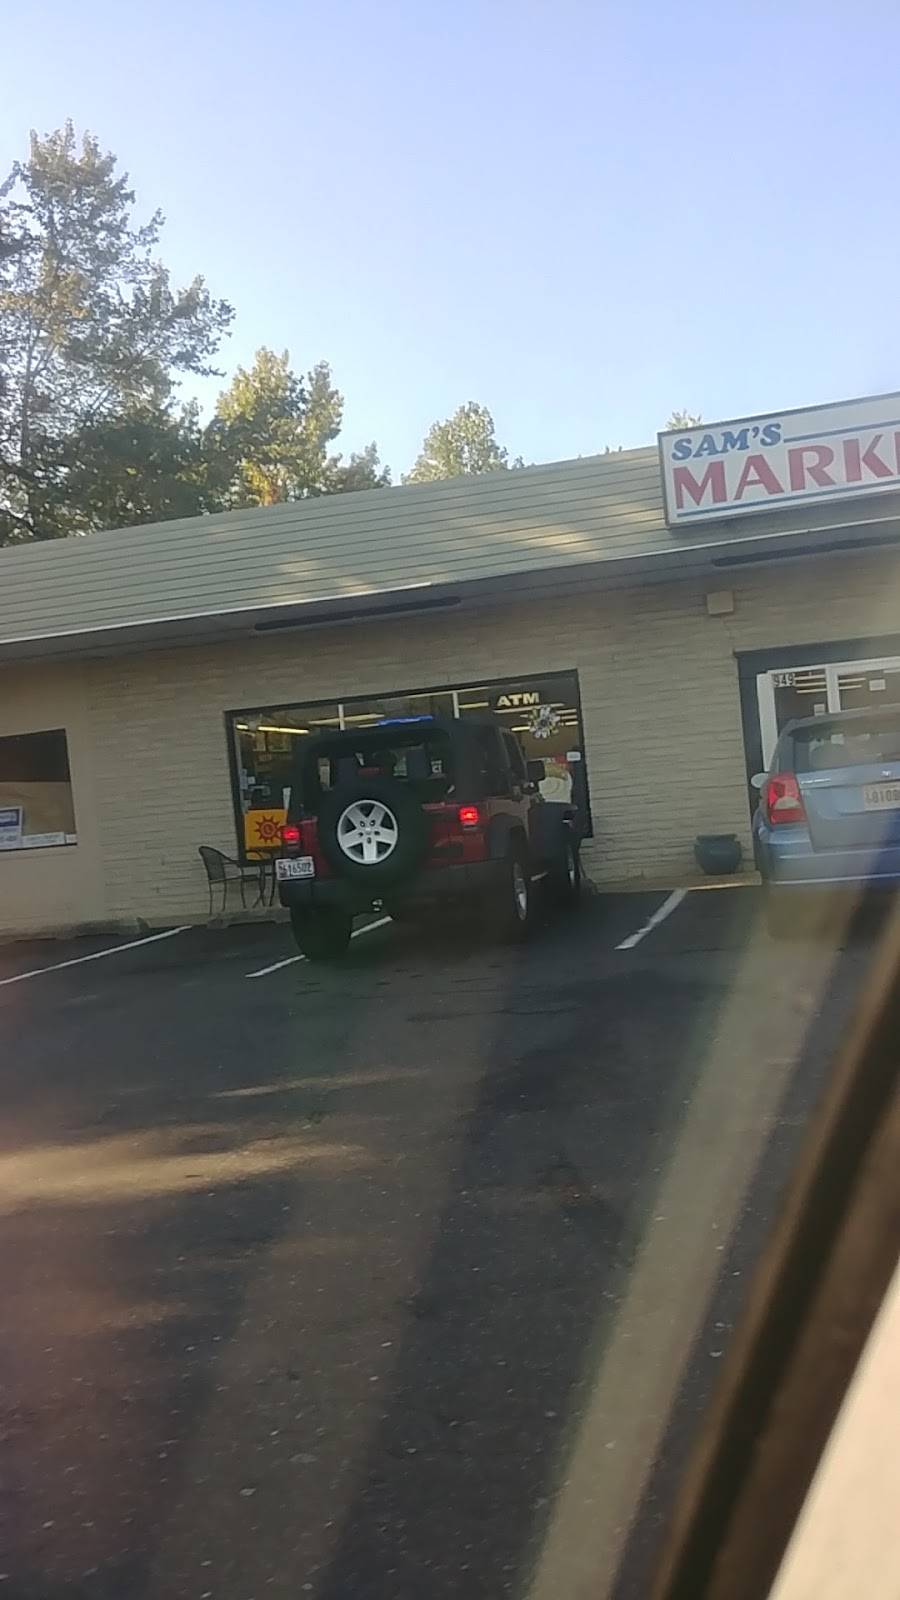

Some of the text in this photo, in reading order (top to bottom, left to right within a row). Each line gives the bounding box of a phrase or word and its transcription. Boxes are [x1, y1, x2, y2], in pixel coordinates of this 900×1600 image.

[671, 422, 782, 461] SAM'S
[672, 429, 900, 510] MARK
[773, 673, 796, 687] 949
[497, 692, 540, 707] ATM
